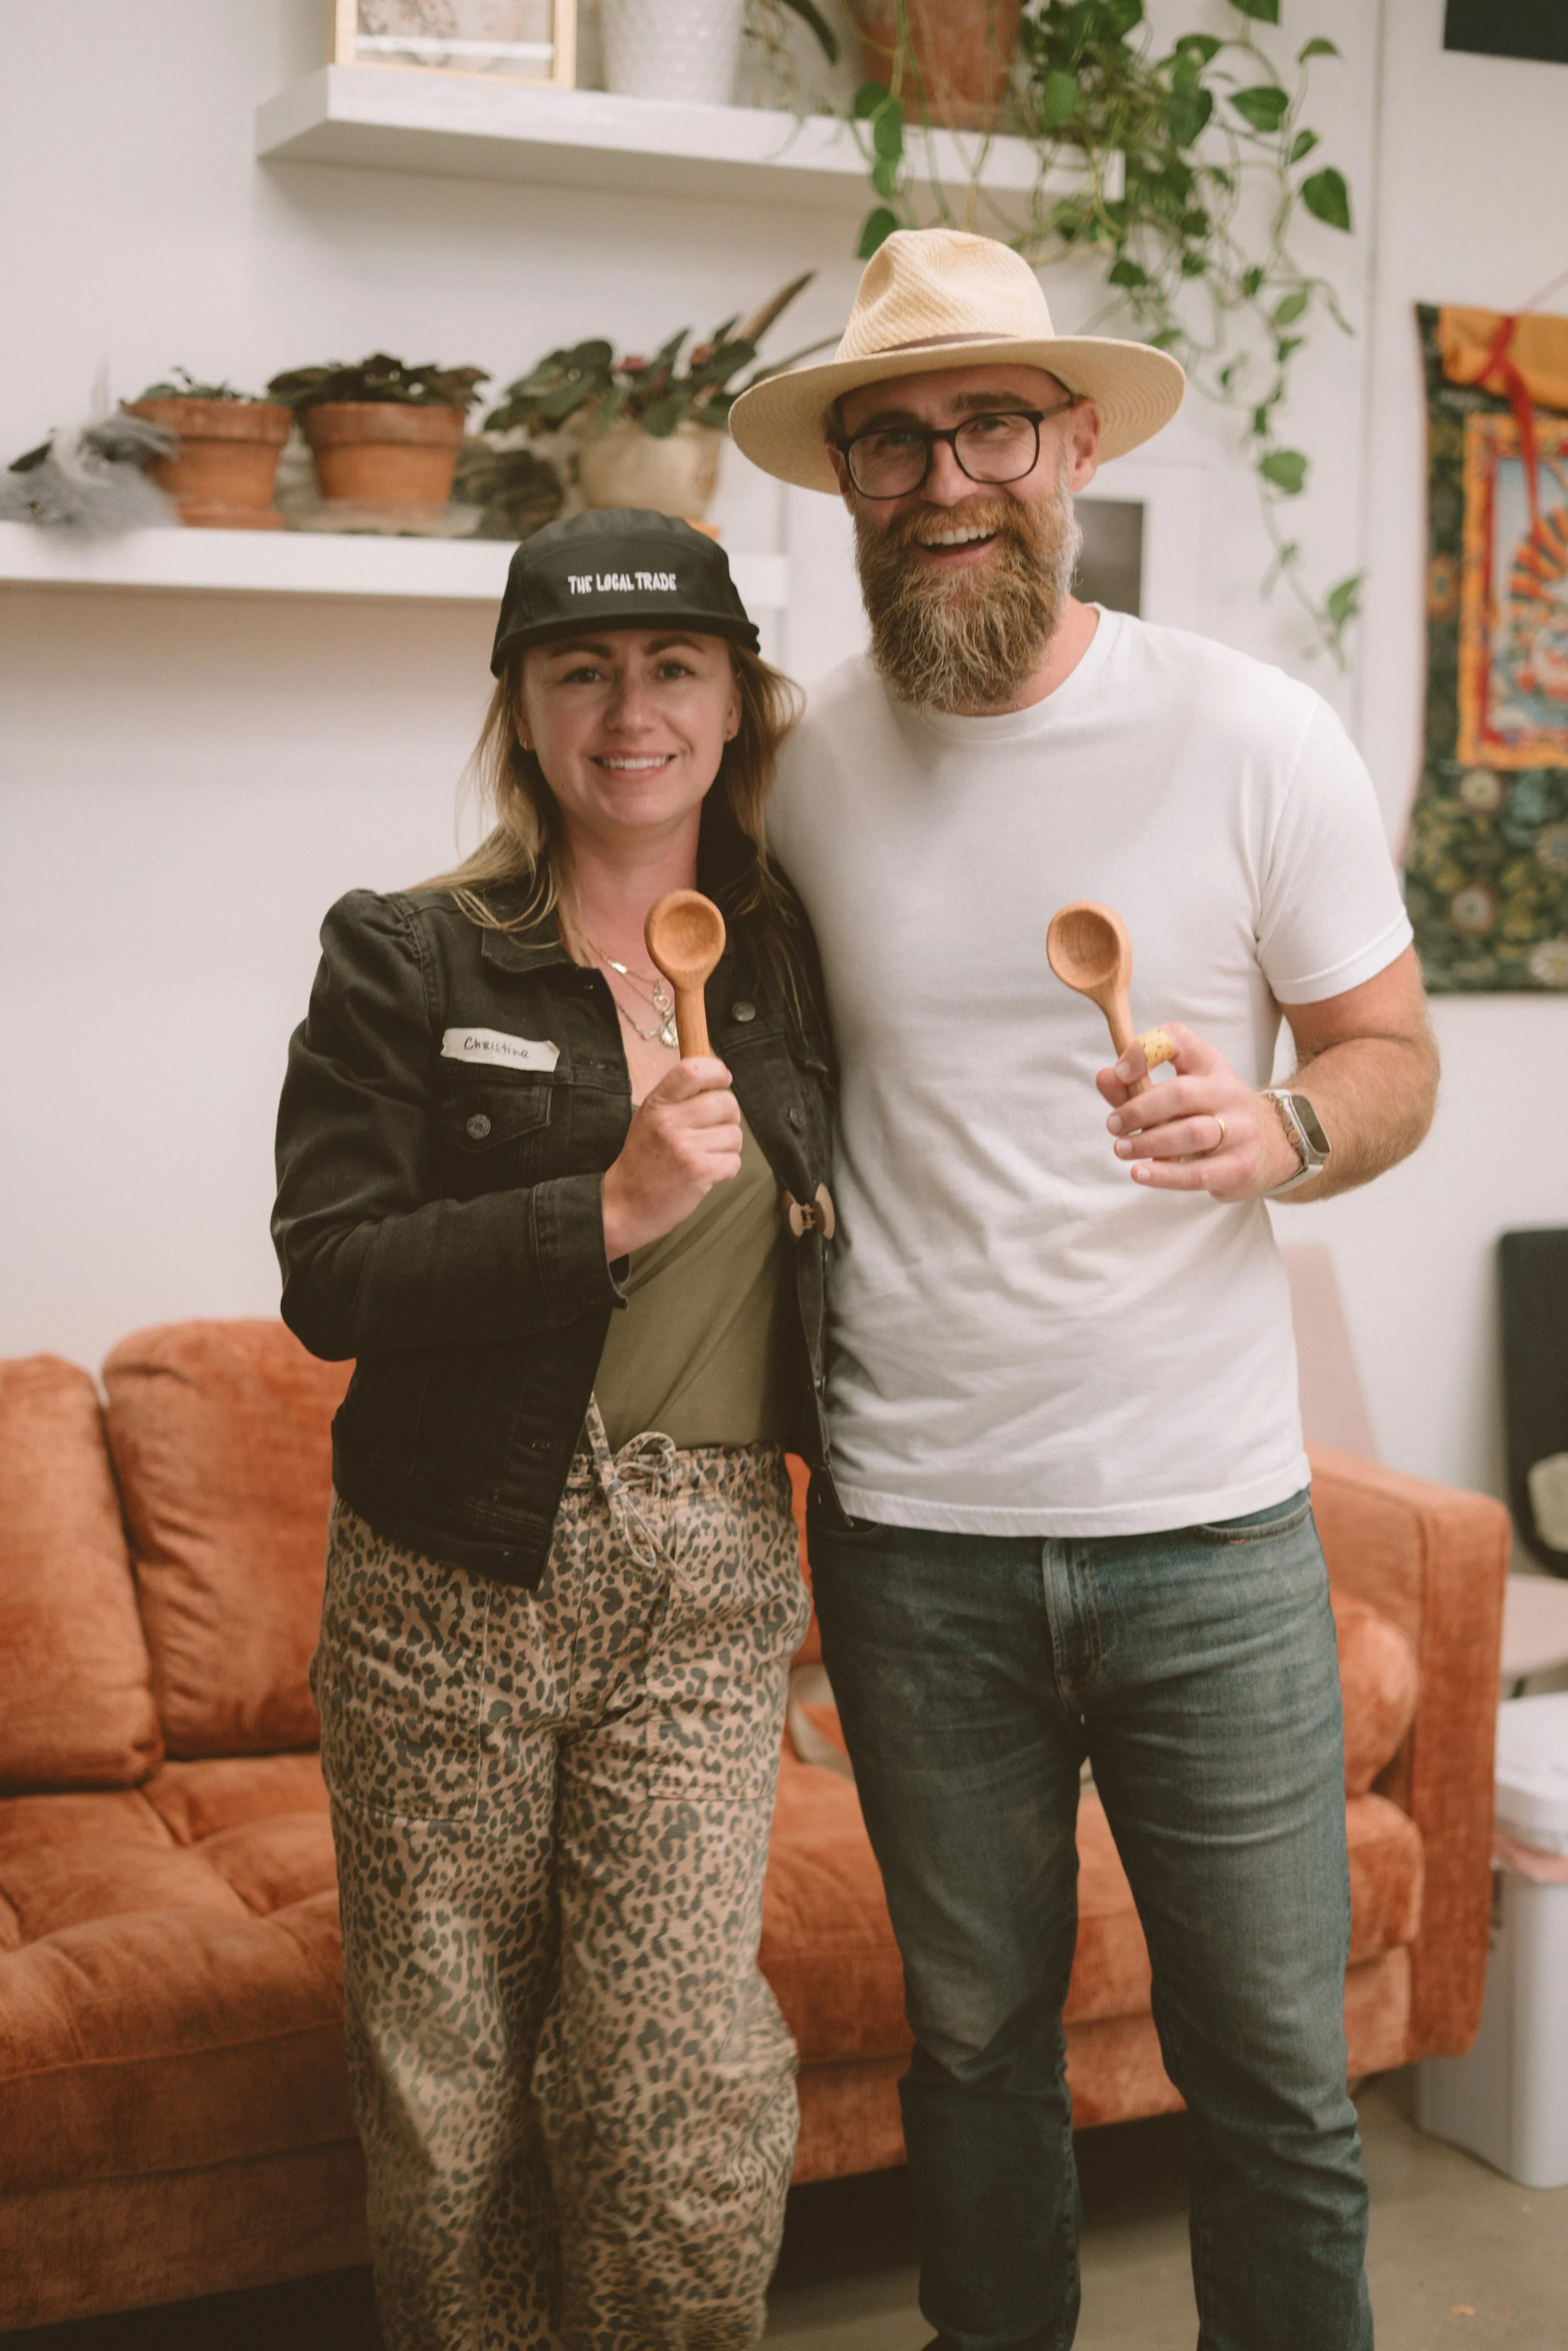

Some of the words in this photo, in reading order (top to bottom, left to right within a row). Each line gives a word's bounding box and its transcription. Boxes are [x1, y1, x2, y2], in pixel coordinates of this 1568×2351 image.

[568, 575, 593, 595] THE
[596, 573, 635, 592] LOCAL
[635, 572, 676, 591] TRADE
